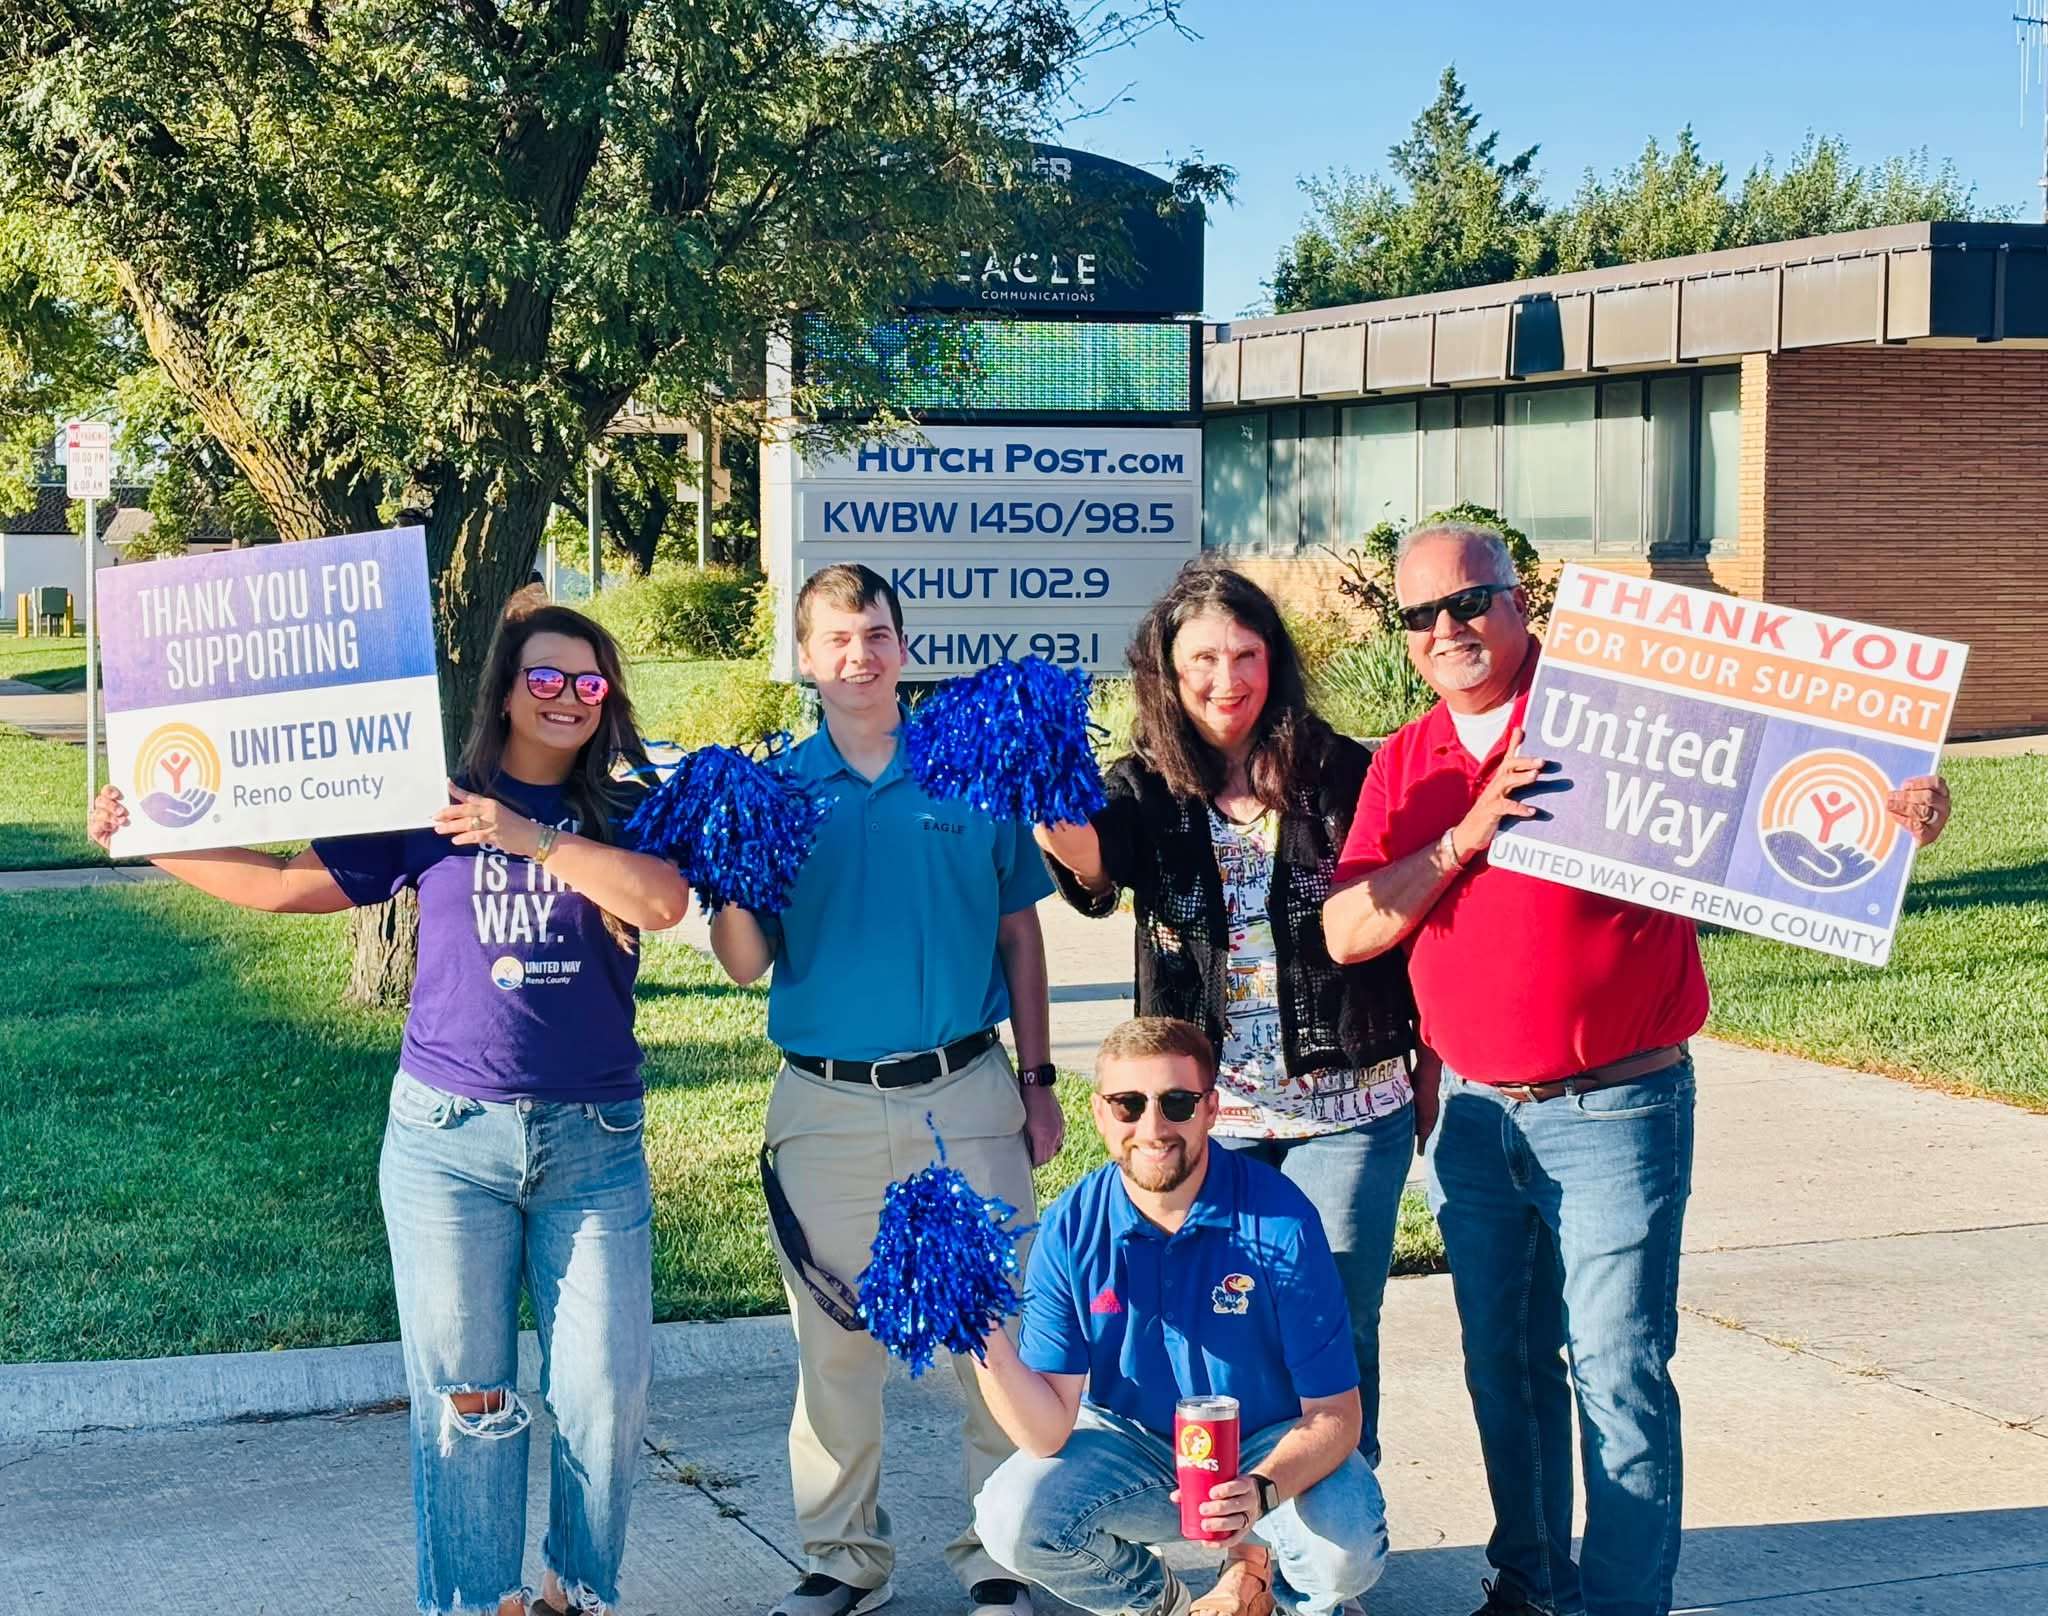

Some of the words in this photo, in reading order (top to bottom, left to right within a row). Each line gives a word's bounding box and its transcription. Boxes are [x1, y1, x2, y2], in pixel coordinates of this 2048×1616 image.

[981, 290, 1095, 302] COMMUNICATIONS
[823, 501, 958, 534] KWBW
[970, 500, 1175, 537] 1450/98.5
[137, 577, 237, 638] THANK
[245, 568, 309, 624] YOU
[321, 559, 383, 616] FOR
[891, 567, 1000, 599] KHUT
[1010, 567, 1110, 599] 102.9
[905, 633, 1018, 665] KHMY
[1029, 633, 1099, 664] 93.1
[1576, 573, 1794, 650] THANK
[1815, 622, 1949, 682] YOU
[166, 619, 360, 690] SUPPORTING
[1551, 622, 1626, 662] FOR
[1639, 639, 1739, 688] YOUR
[1751, 665, 1941, 731] SUPPORT
[230, 720, 338, 768] UNITED
[346, 711, 412, 755] WAY
[1540, 687, 1746, 789] United
[233, 785, 292, 808] Reno
[300, 773, 384, 800] County
[923, 821, 965, 834] EAGLE
[1604, 770, 1729, 868] Way
[473, 850, 508, 892] IS
[472, 893, 564, 944] WAY.
[1493, 839, 1583, 879] UNITED
[1590, 863, 1646, 896] WAY
[1649, 880, 1687, 905] OF
[1691, 890, 1764, 927] RENO
[1770, 912, 1888, 958] COUNTY
[525, 961, 559, 974] UNITED
[561, 960, 582, 973] WAY
[525, 976, 544, 985] Reno
[546, 975, 571, 985] County
